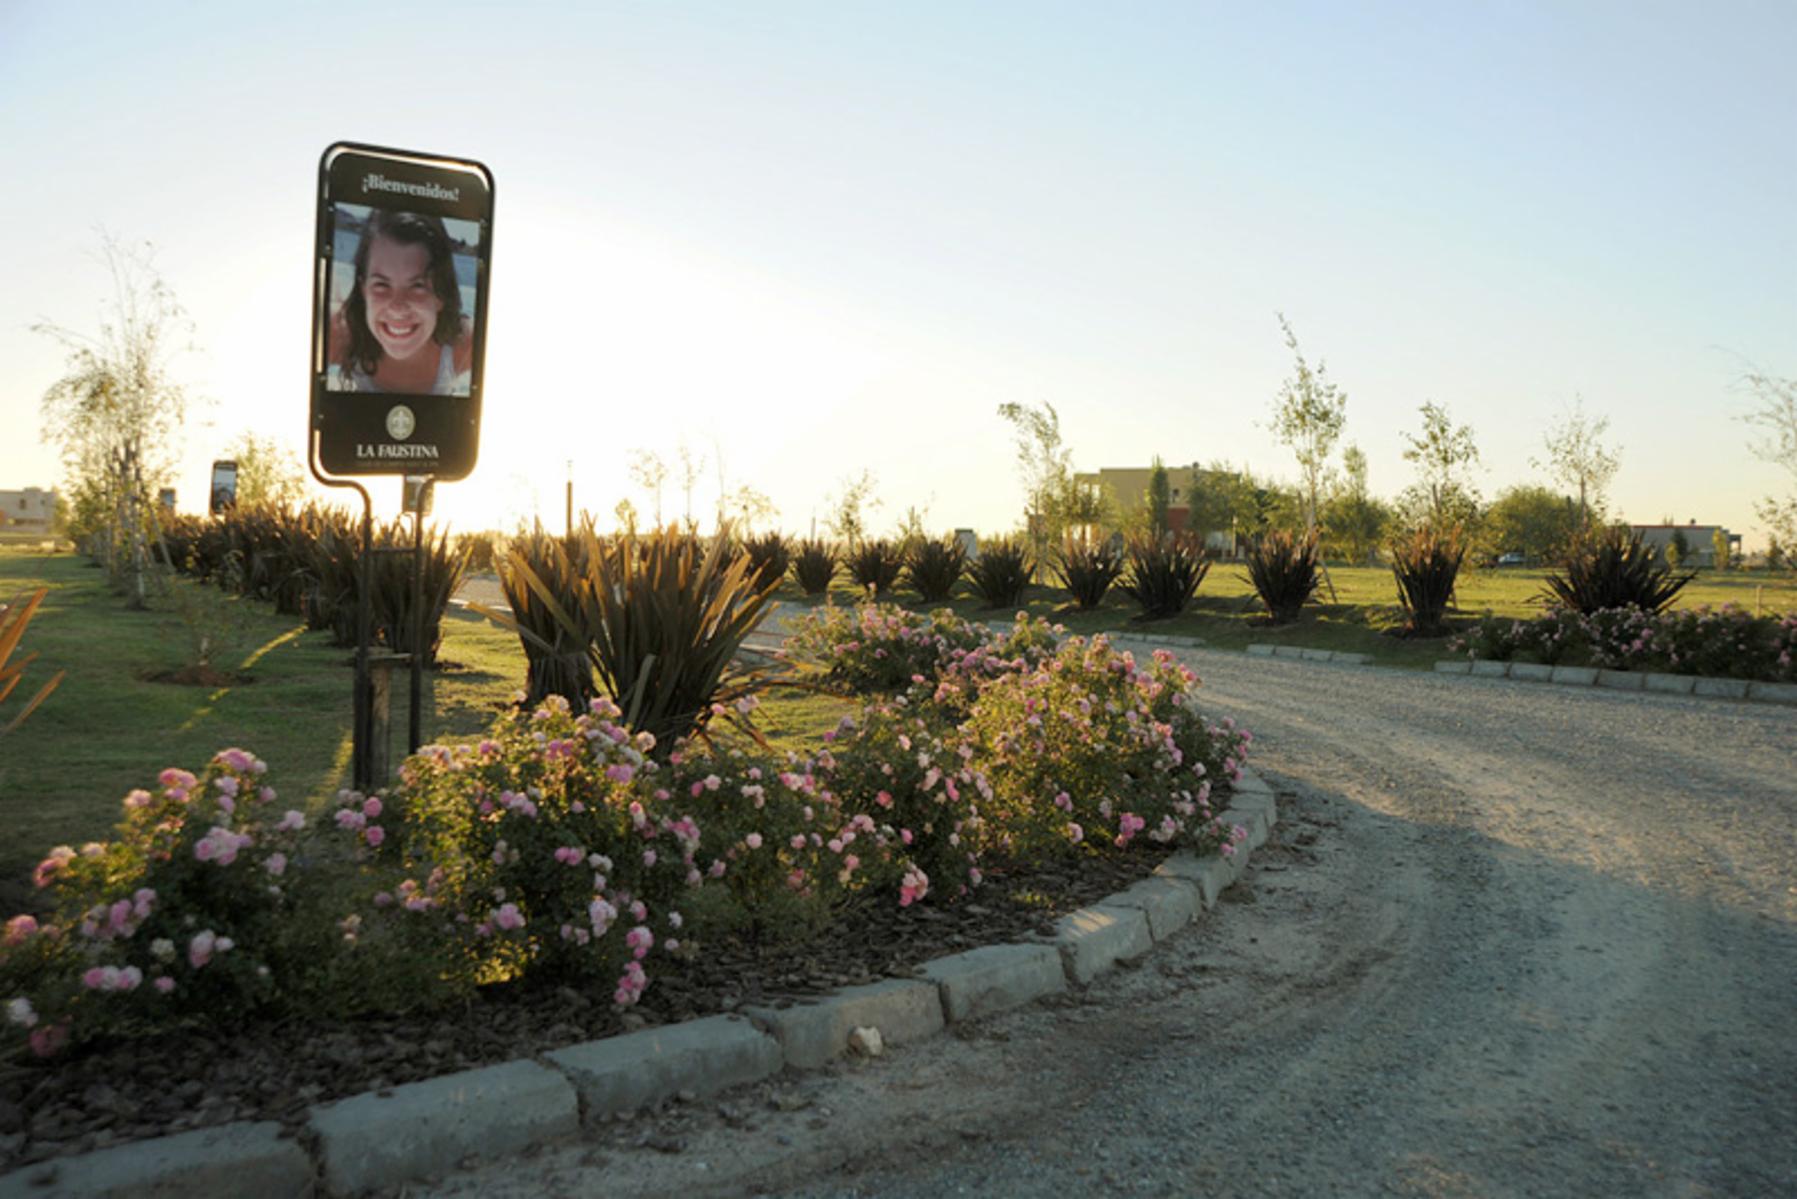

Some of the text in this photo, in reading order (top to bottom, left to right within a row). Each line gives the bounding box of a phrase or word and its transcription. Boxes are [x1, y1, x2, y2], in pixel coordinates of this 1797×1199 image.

[362, 173, 460, 201] ¡Bienvenidos!
[356, 443, 440, 458] LA FAUSTINA
